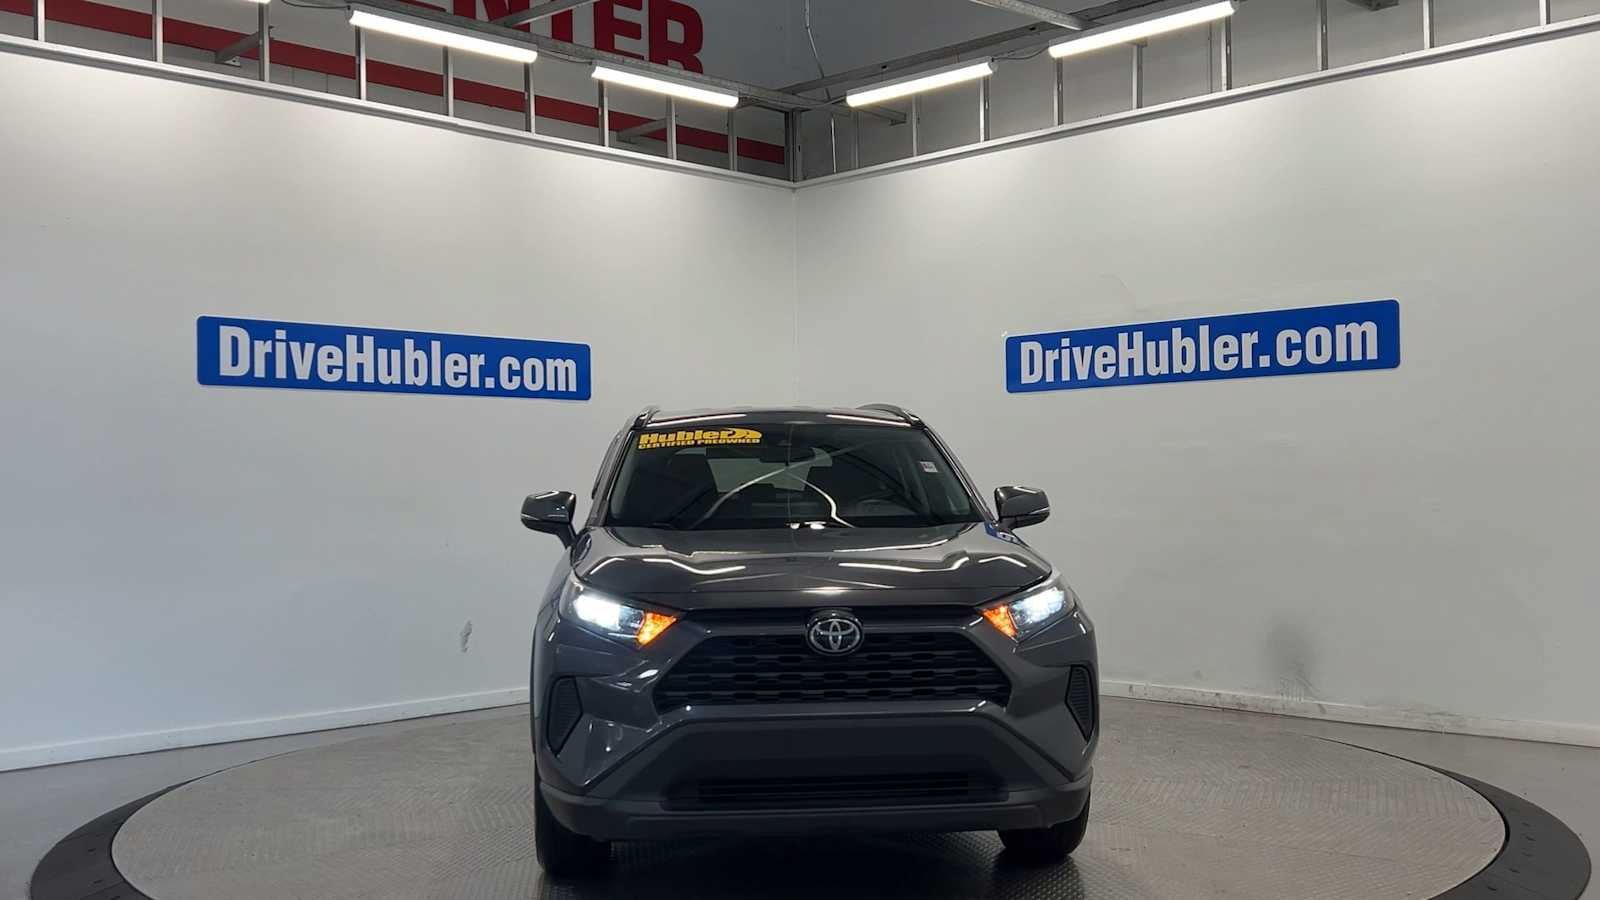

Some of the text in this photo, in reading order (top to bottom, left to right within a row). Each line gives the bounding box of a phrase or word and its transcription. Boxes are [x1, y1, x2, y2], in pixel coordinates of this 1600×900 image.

[400, 0, 704, 74] NER
[218, 325, 577, 392] DriveHubler.com
[1019, 321, 1379, 384] DriveHubler.com
[638, 437, 761, 450] CERTIFIED PREOWNED
[640, 428, 737, 444] Hubler
